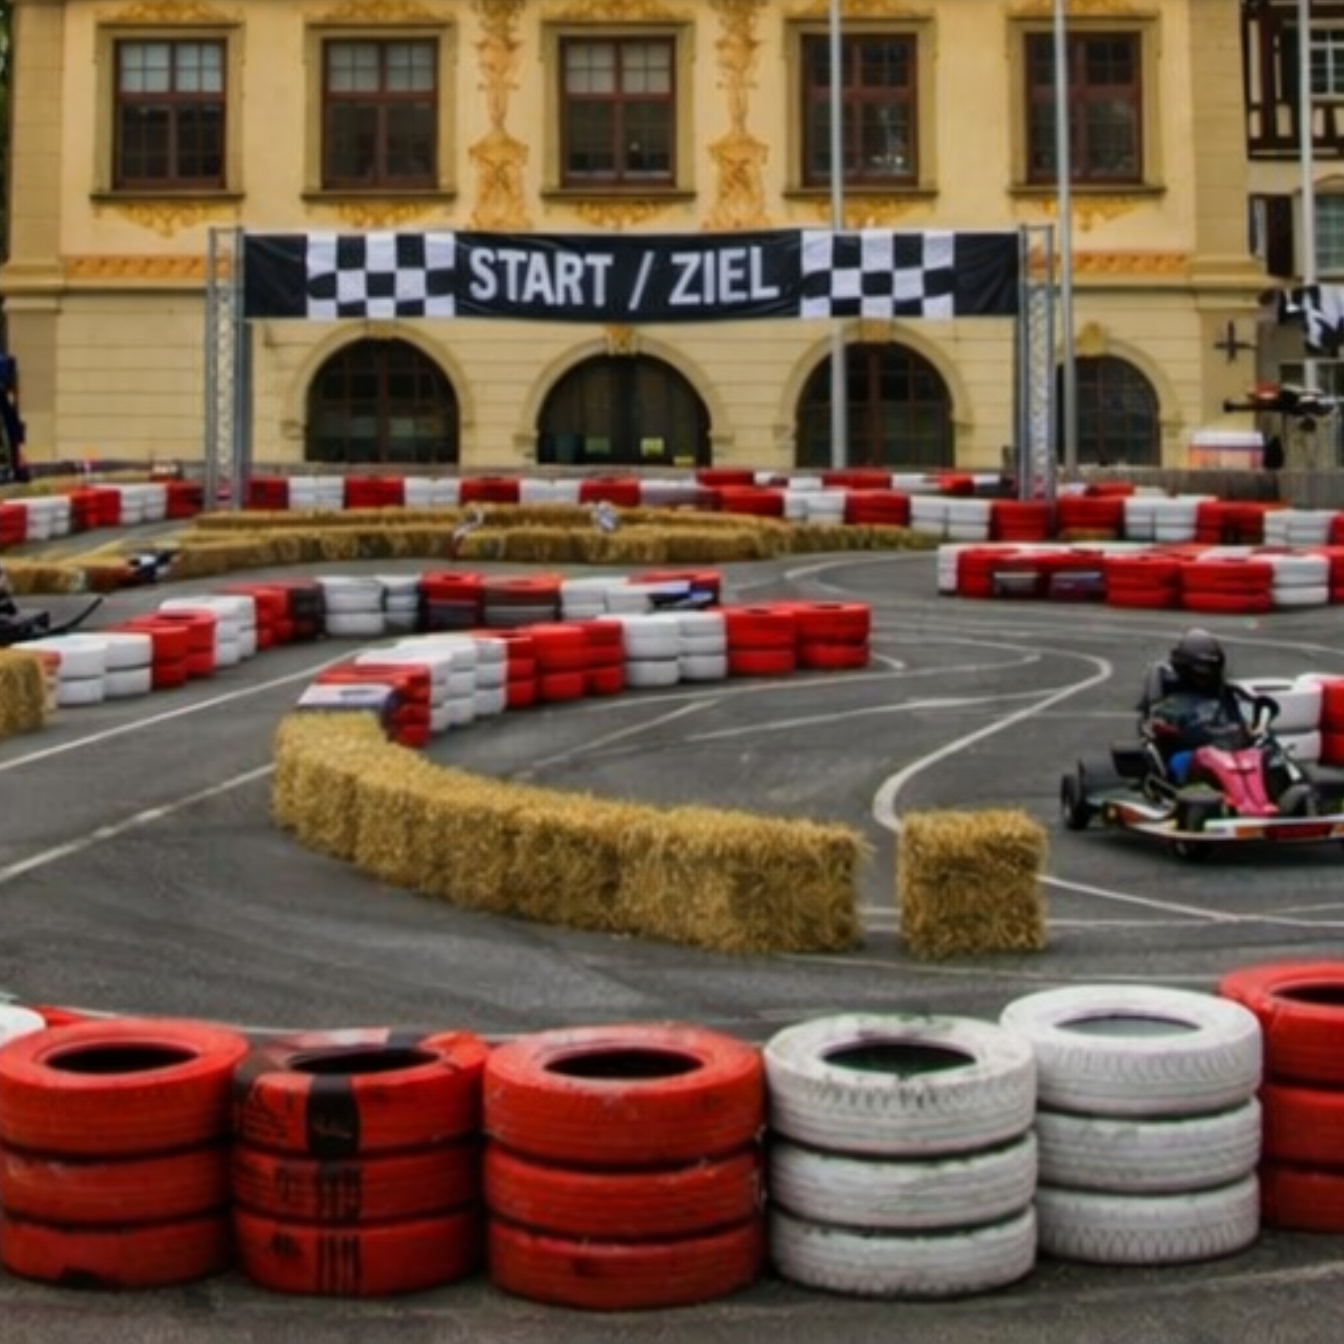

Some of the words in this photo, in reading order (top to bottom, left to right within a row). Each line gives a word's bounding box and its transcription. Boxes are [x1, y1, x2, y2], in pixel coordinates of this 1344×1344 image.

[469, 247, 614, 307] START
[627, 250, 655, 311] /
[669, 245, 781, 306] ZIEL
